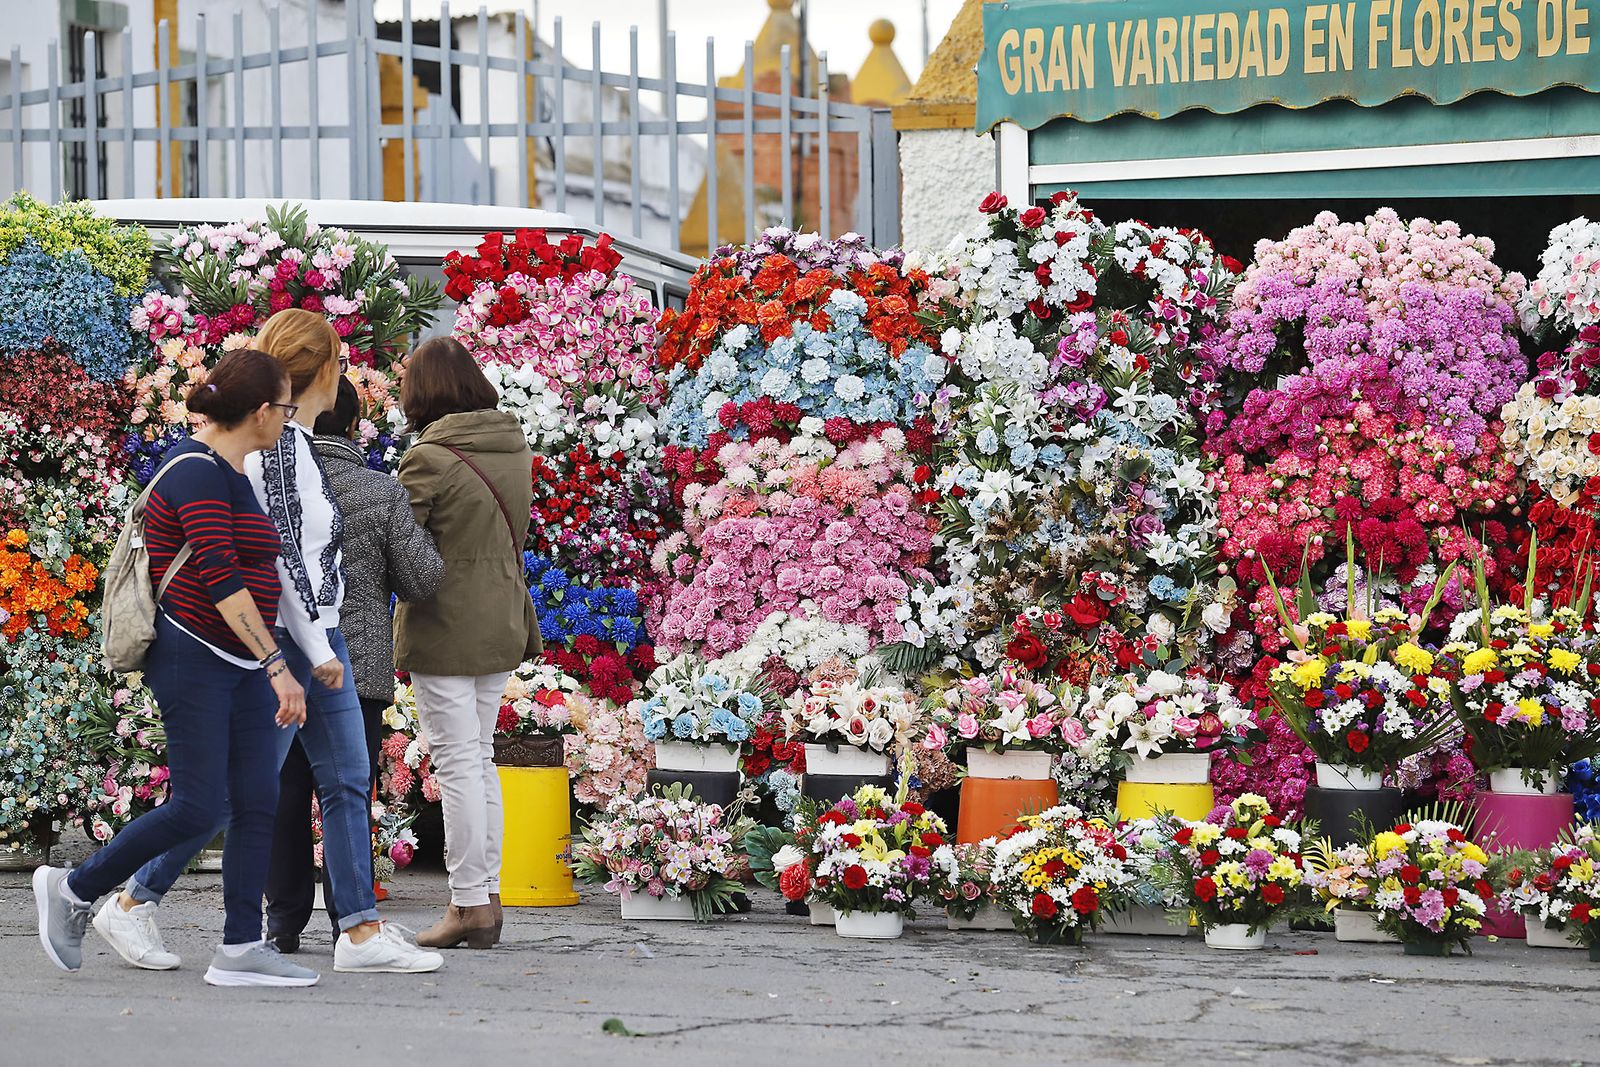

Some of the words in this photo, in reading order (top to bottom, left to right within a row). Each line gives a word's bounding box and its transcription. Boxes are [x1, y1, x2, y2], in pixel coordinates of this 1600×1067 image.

[997, 23, 1096, 95] GRAN
[1107, 8, 1290, 88] VARIEDAD
[1303, 2, 1356, 74] EN
[1368, 0, 1523, 70] FLORES
[1537, 0, 1591, 58] DE
